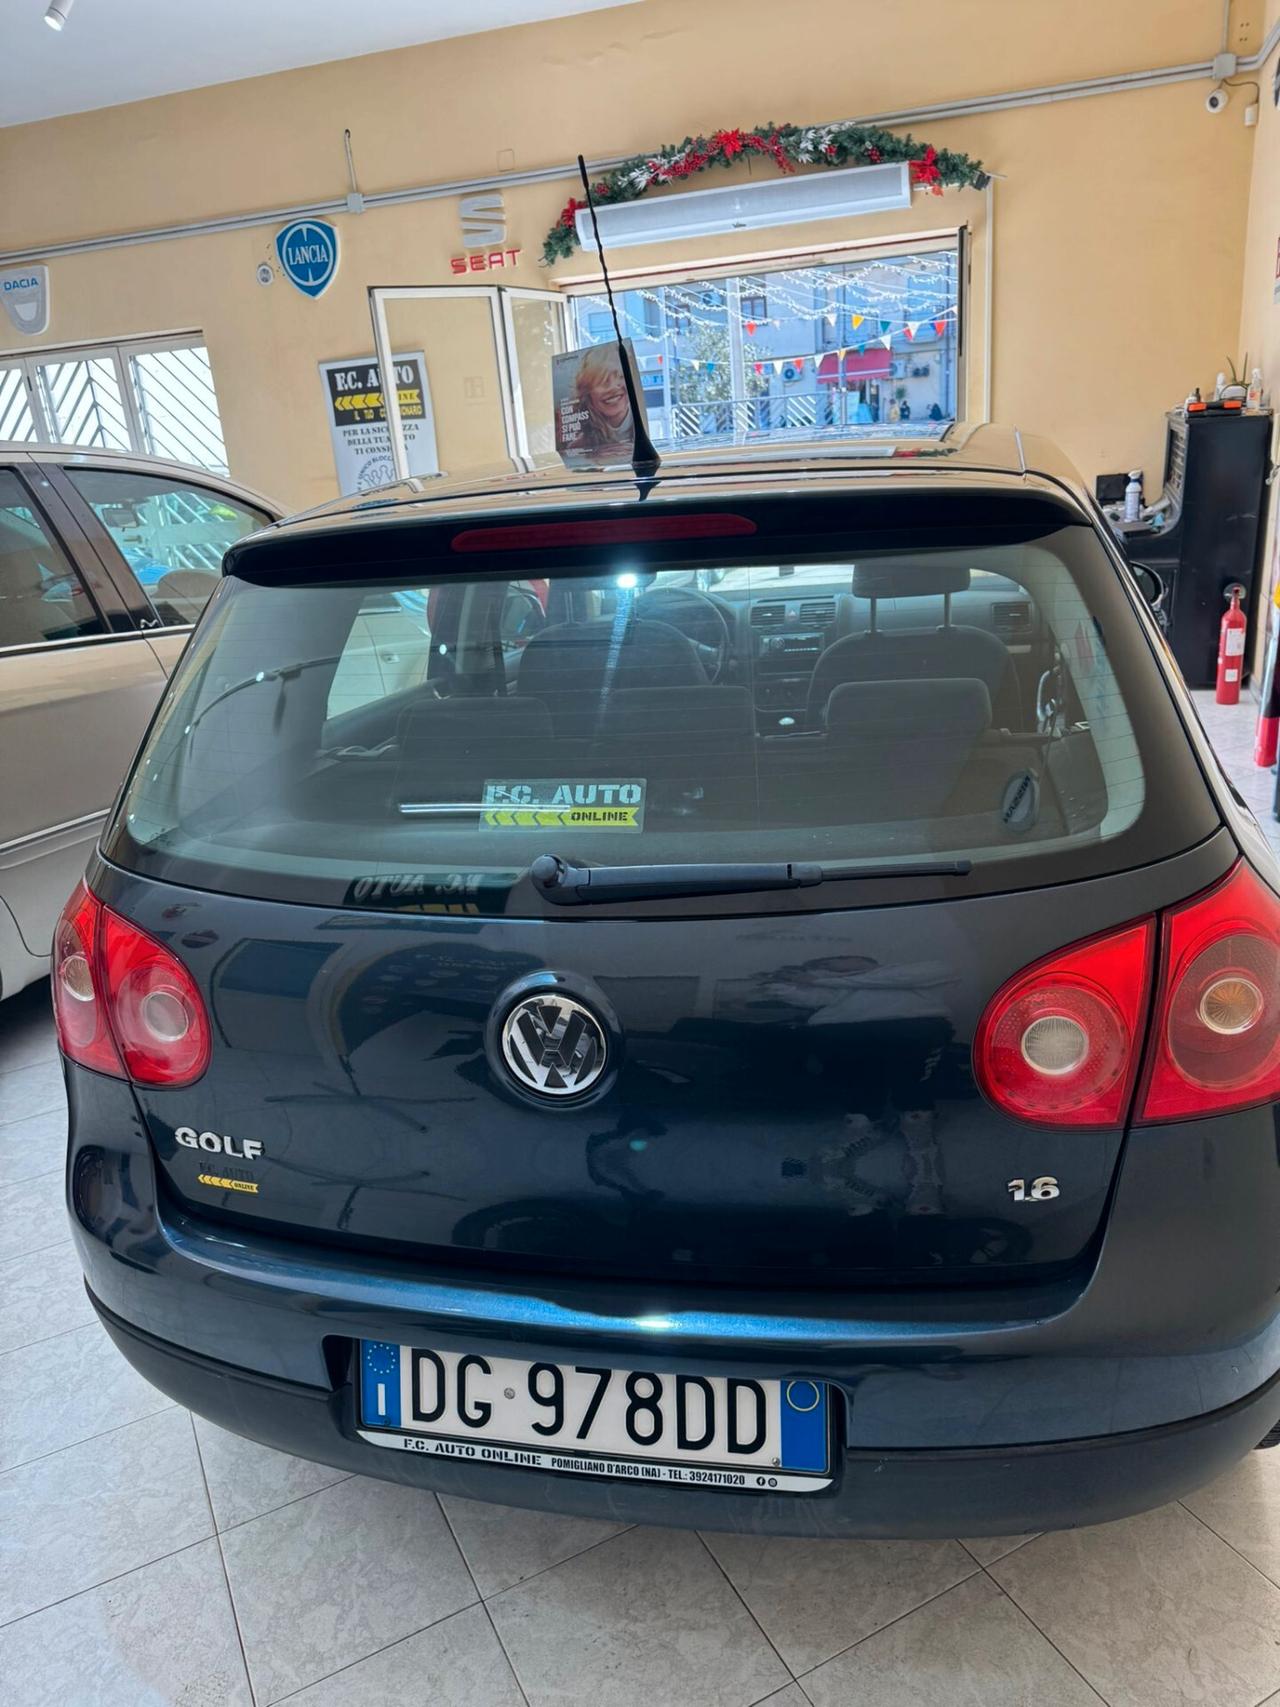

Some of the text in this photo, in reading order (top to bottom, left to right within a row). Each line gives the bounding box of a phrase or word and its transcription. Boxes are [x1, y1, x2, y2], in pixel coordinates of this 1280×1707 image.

[288, 244, 328, 266] LANCIA
[450, 249, 521, 275] SEAT
[4, 276, 39, 291] DACIA
[367, 365, 414, 388] ATO
[343, 428, 358, 437] PER
[360, 427, 370, 435] LA
[347, 436, 372, 446] DELLA
[354, 447, 364, 455] TI
[552, 784, 641, 804] AUTO
[570, 811, 629, 822] ONLINE
[175, 1127, 263, 1160] GOLF
[411, 1348, 492, 1428] DG
[528, 1361, 767, 1455] 978DD
[403, 1438, 429, 1451] F.C.
[435, 1442, 476, 1457] AUTO
[481, 1448, 542, 1466] ONLINE
[551, 1457, 605, 1474] POMIGLIANO
[607, 1462, 640, 1477] D'ARCO
[641, 1465, 661, 1478] (NA)
[689, 1470, 746, 1486] 3924171020
